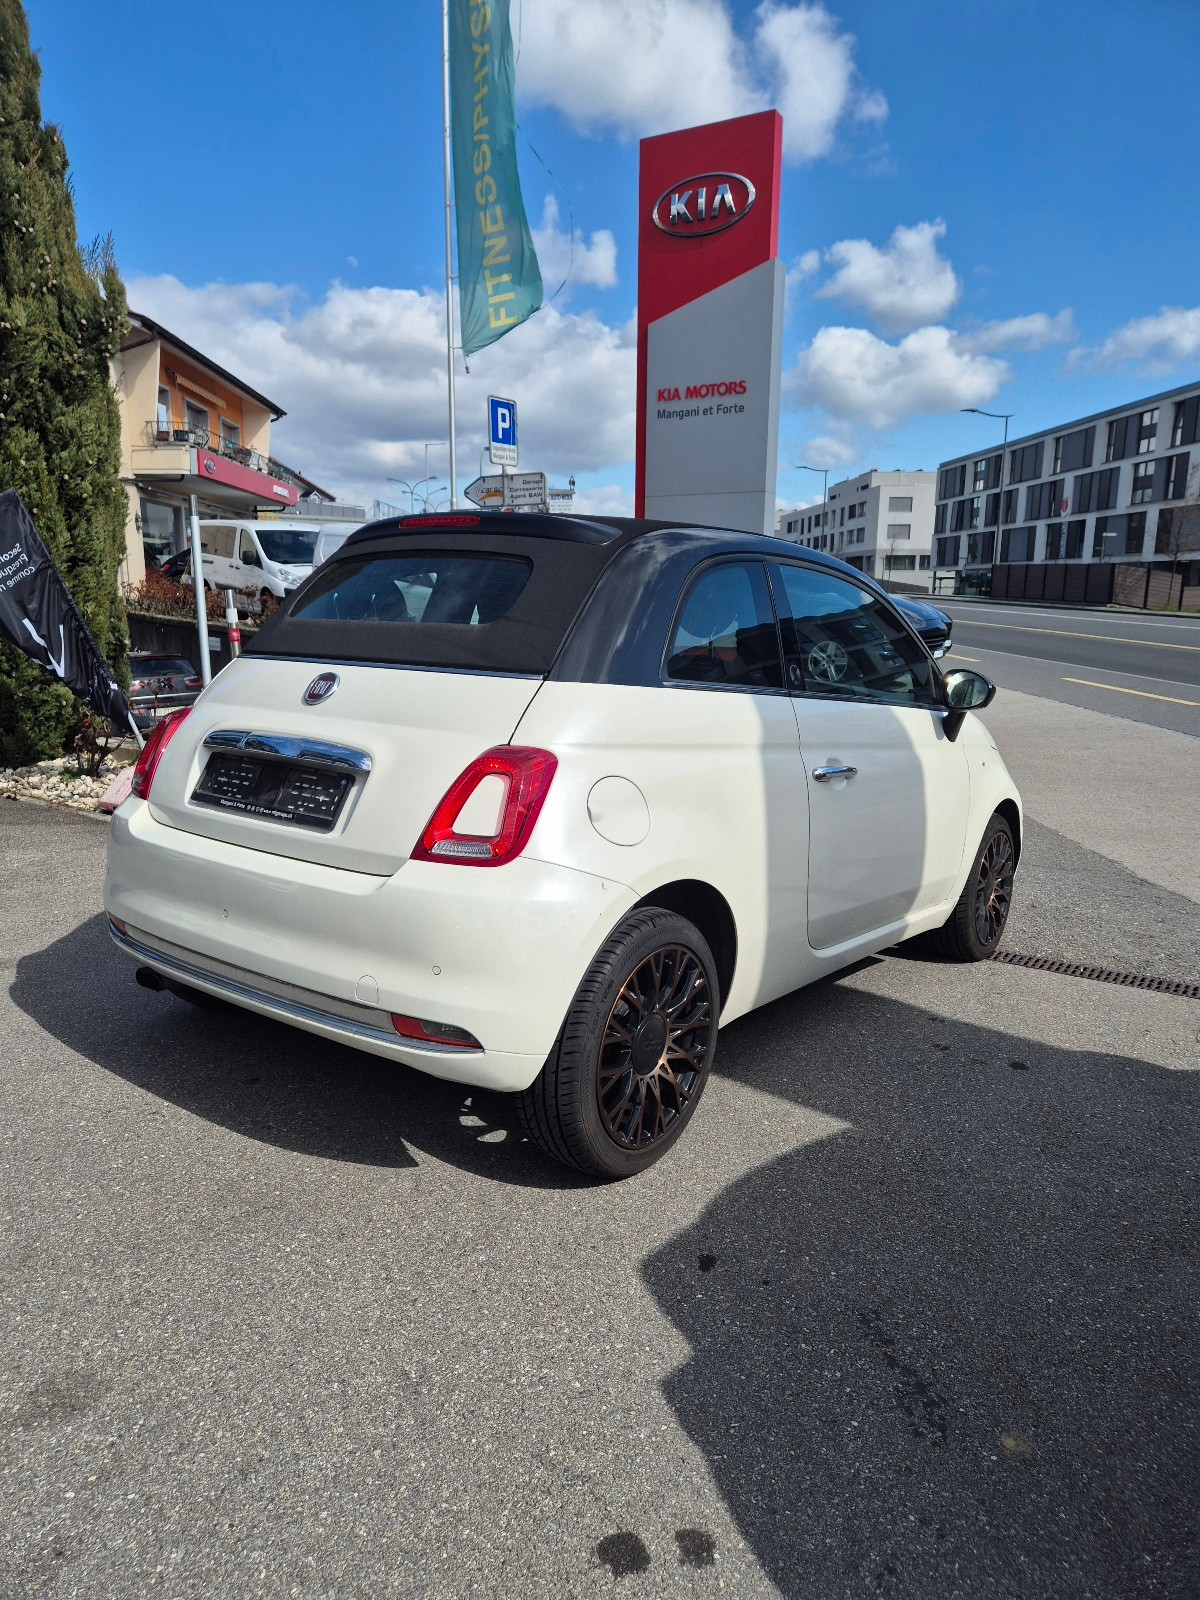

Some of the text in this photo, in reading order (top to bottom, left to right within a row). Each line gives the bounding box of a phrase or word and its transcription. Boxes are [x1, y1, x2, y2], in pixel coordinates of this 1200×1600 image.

[669, 183, 737, 225] KIA
[657, 380, 747, 401] KIA MOTORS
[498, 407, 510, 439] P
[657, 403, 745, 420] Mangani et Forte
